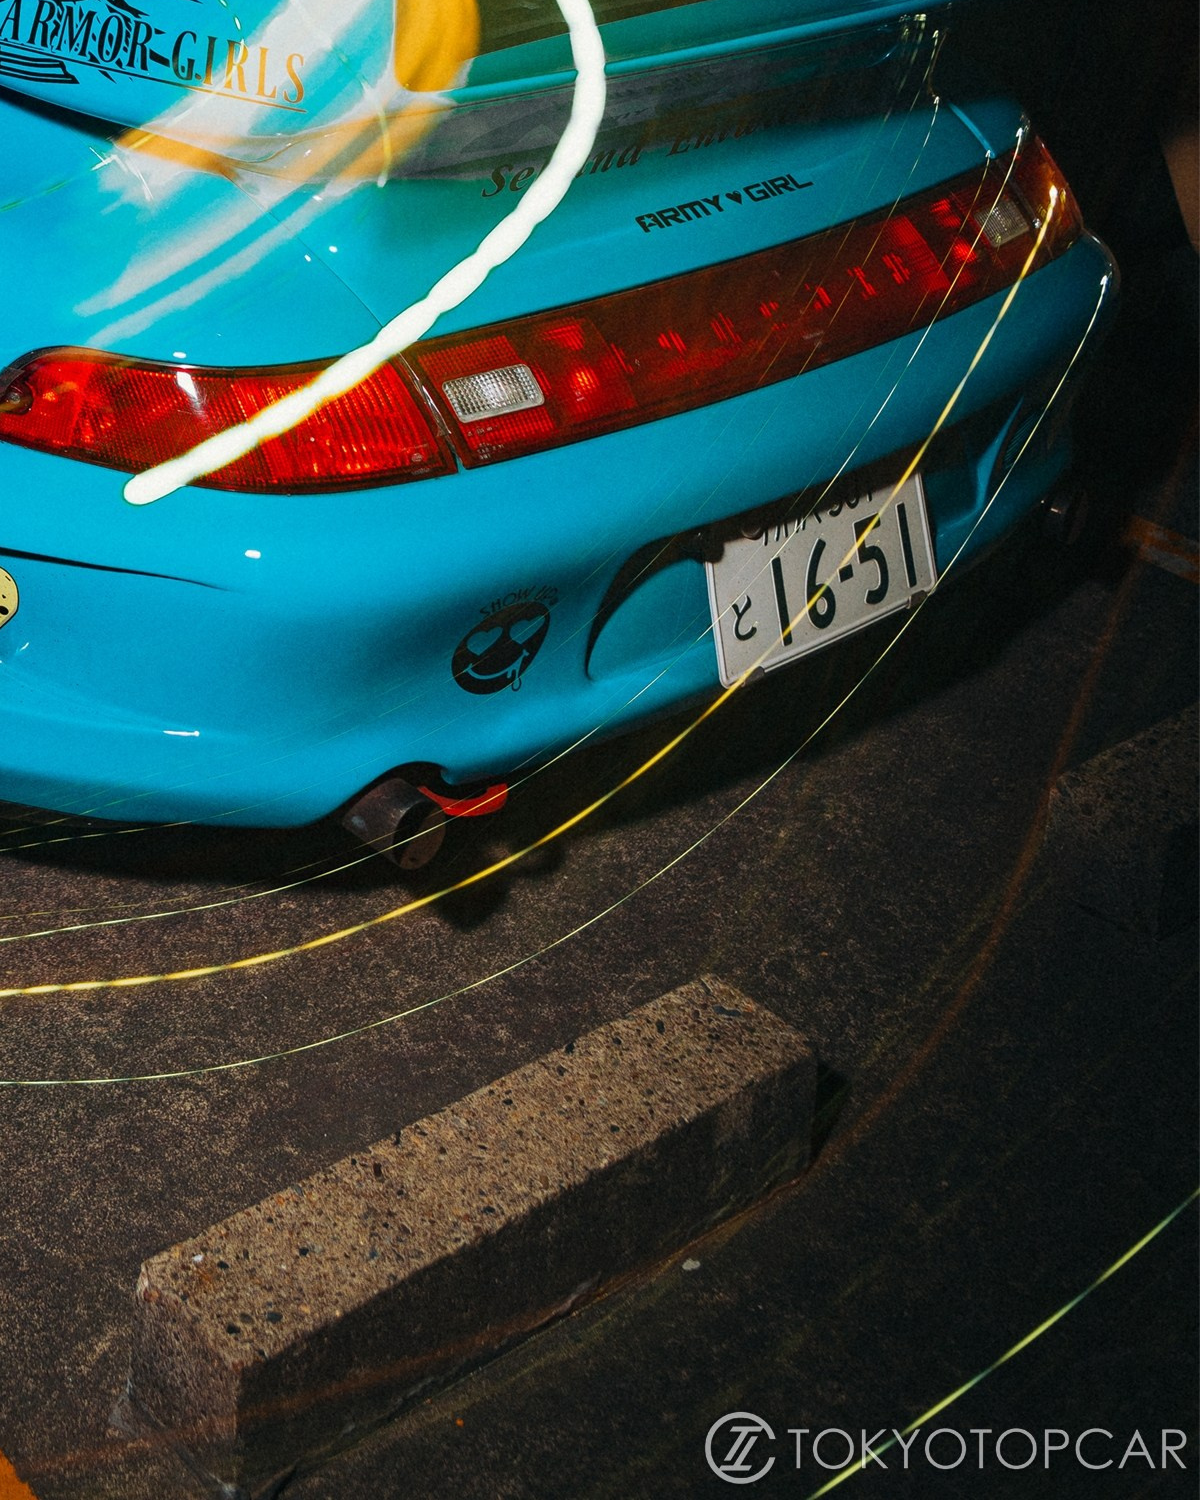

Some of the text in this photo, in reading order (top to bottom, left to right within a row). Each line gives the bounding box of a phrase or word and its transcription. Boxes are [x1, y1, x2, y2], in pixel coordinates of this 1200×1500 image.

[635, 173, 815, 233] ARMY GIRL
[770, 501, 918, 647] 16-51
[731, 594, 758, 641] と
